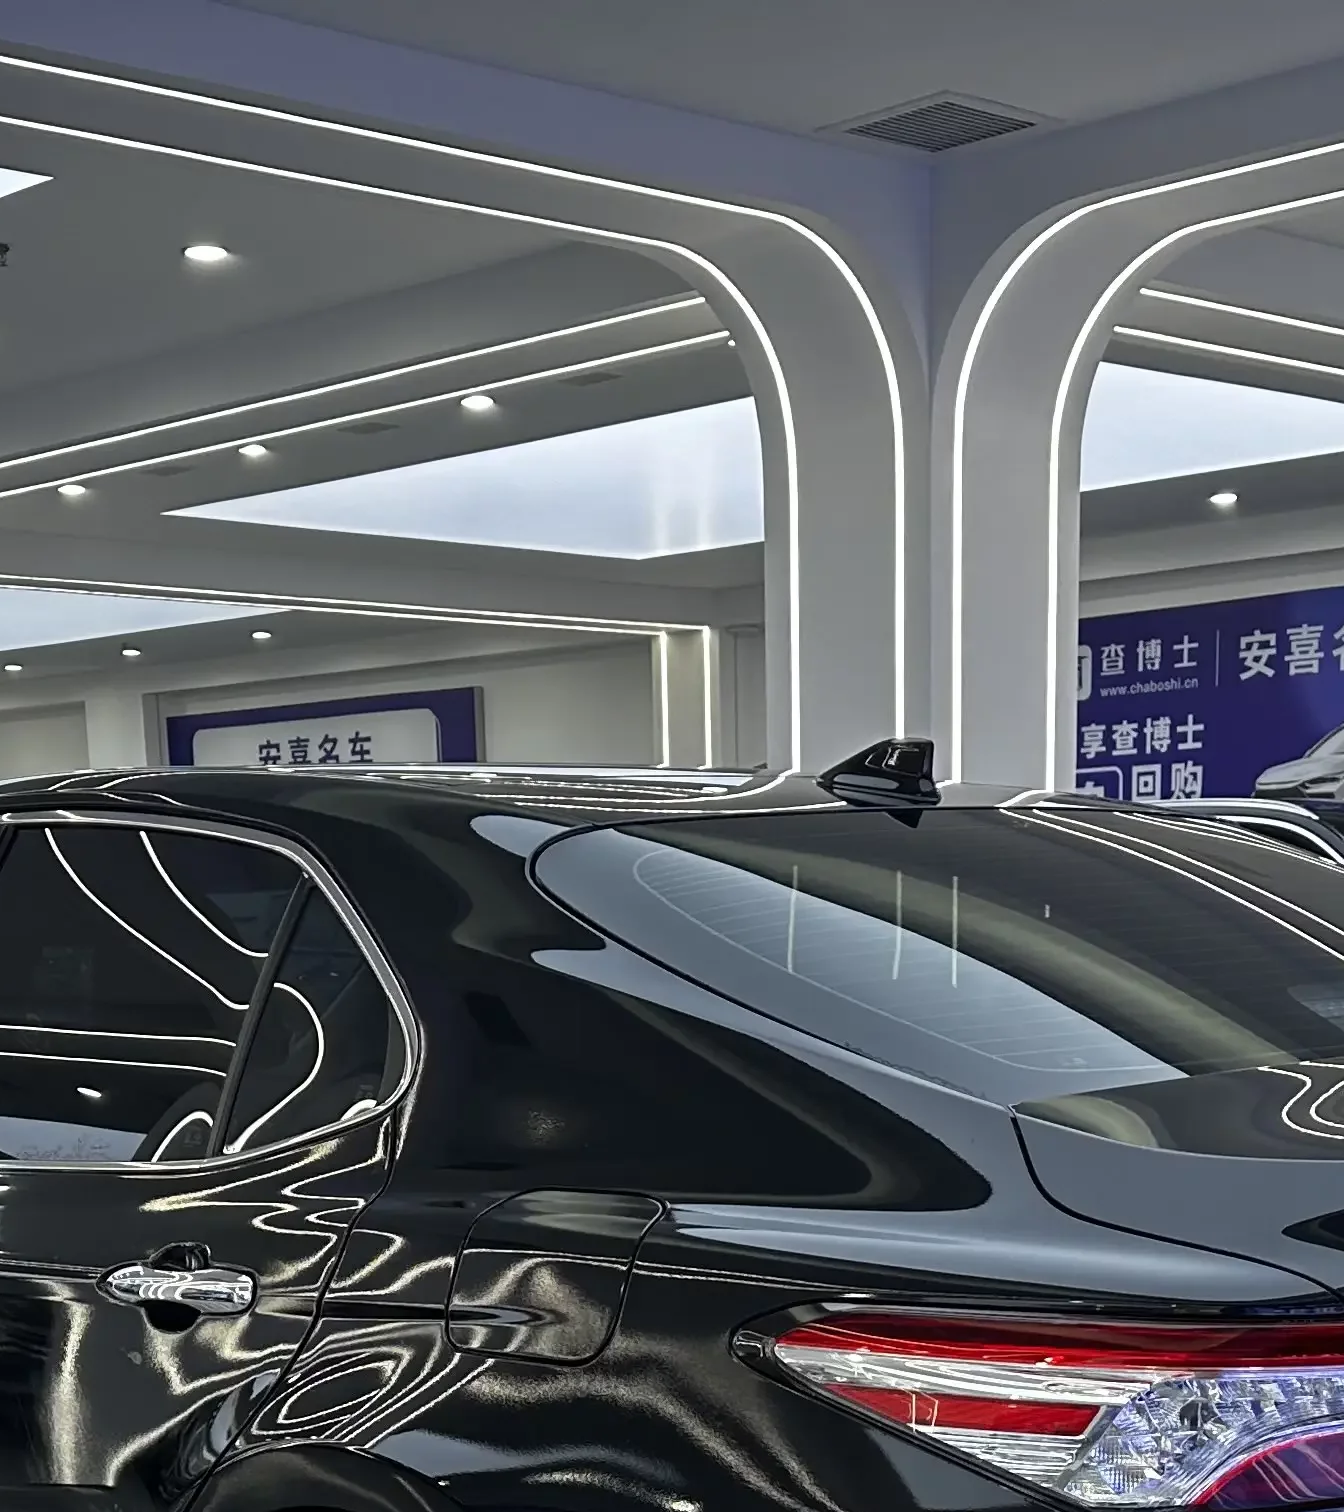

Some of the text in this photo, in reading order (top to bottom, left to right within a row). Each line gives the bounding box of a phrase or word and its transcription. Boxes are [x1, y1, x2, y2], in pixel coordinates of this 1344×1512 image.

[1100, 635, 1199, 676] 查博士
[1099, 677, 1199, 697] www.chaboshi.cn
[257, 731, 374, 765] 安喜名车
[1080, 714, 1205, 759] 享查博士
[1131, 760, 1204, 800] 回购
